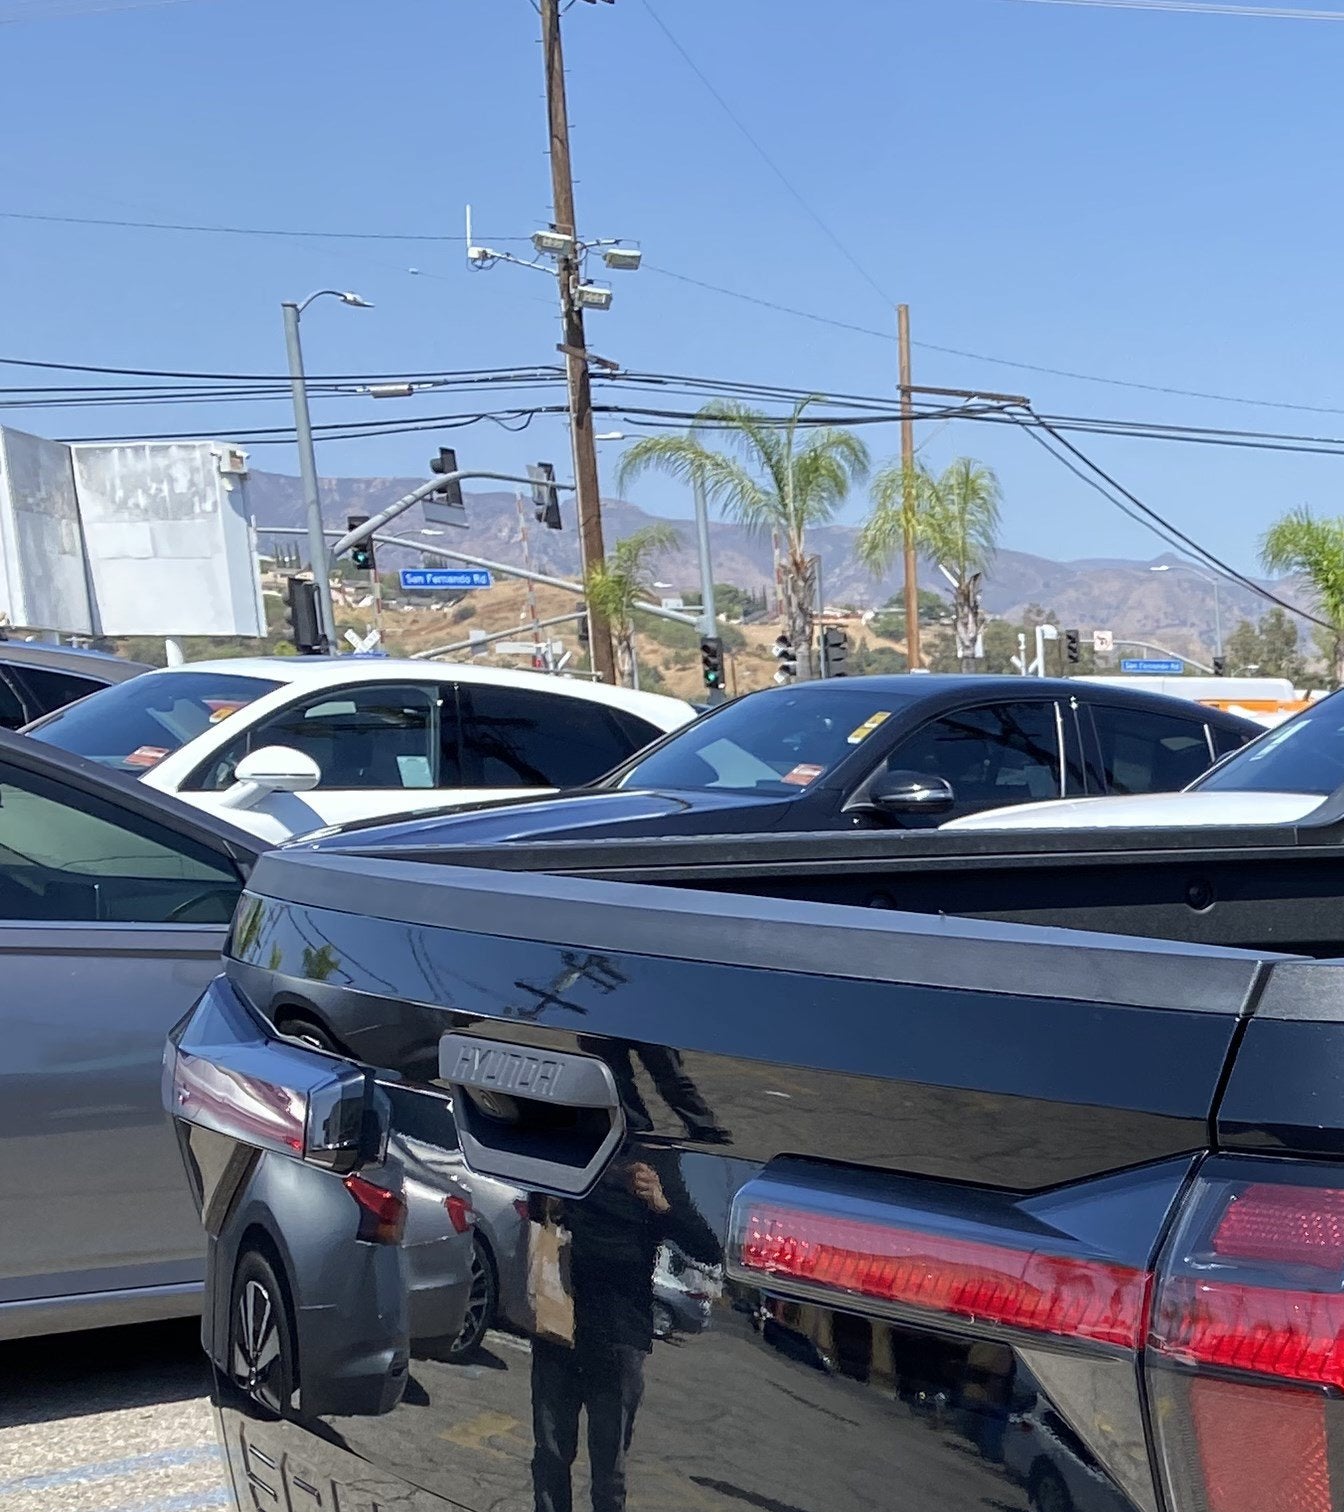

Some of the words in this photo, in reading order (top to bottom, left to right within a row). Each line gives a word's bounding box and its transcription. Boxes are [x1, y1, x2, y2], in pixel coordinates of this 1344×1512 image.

[404, 573, 424, 584] San
[426, 573, 471, 584] Fernando
[473, 573, 487, 584] Rd
[451, 1045, 566, 1097] HYUNDAI
